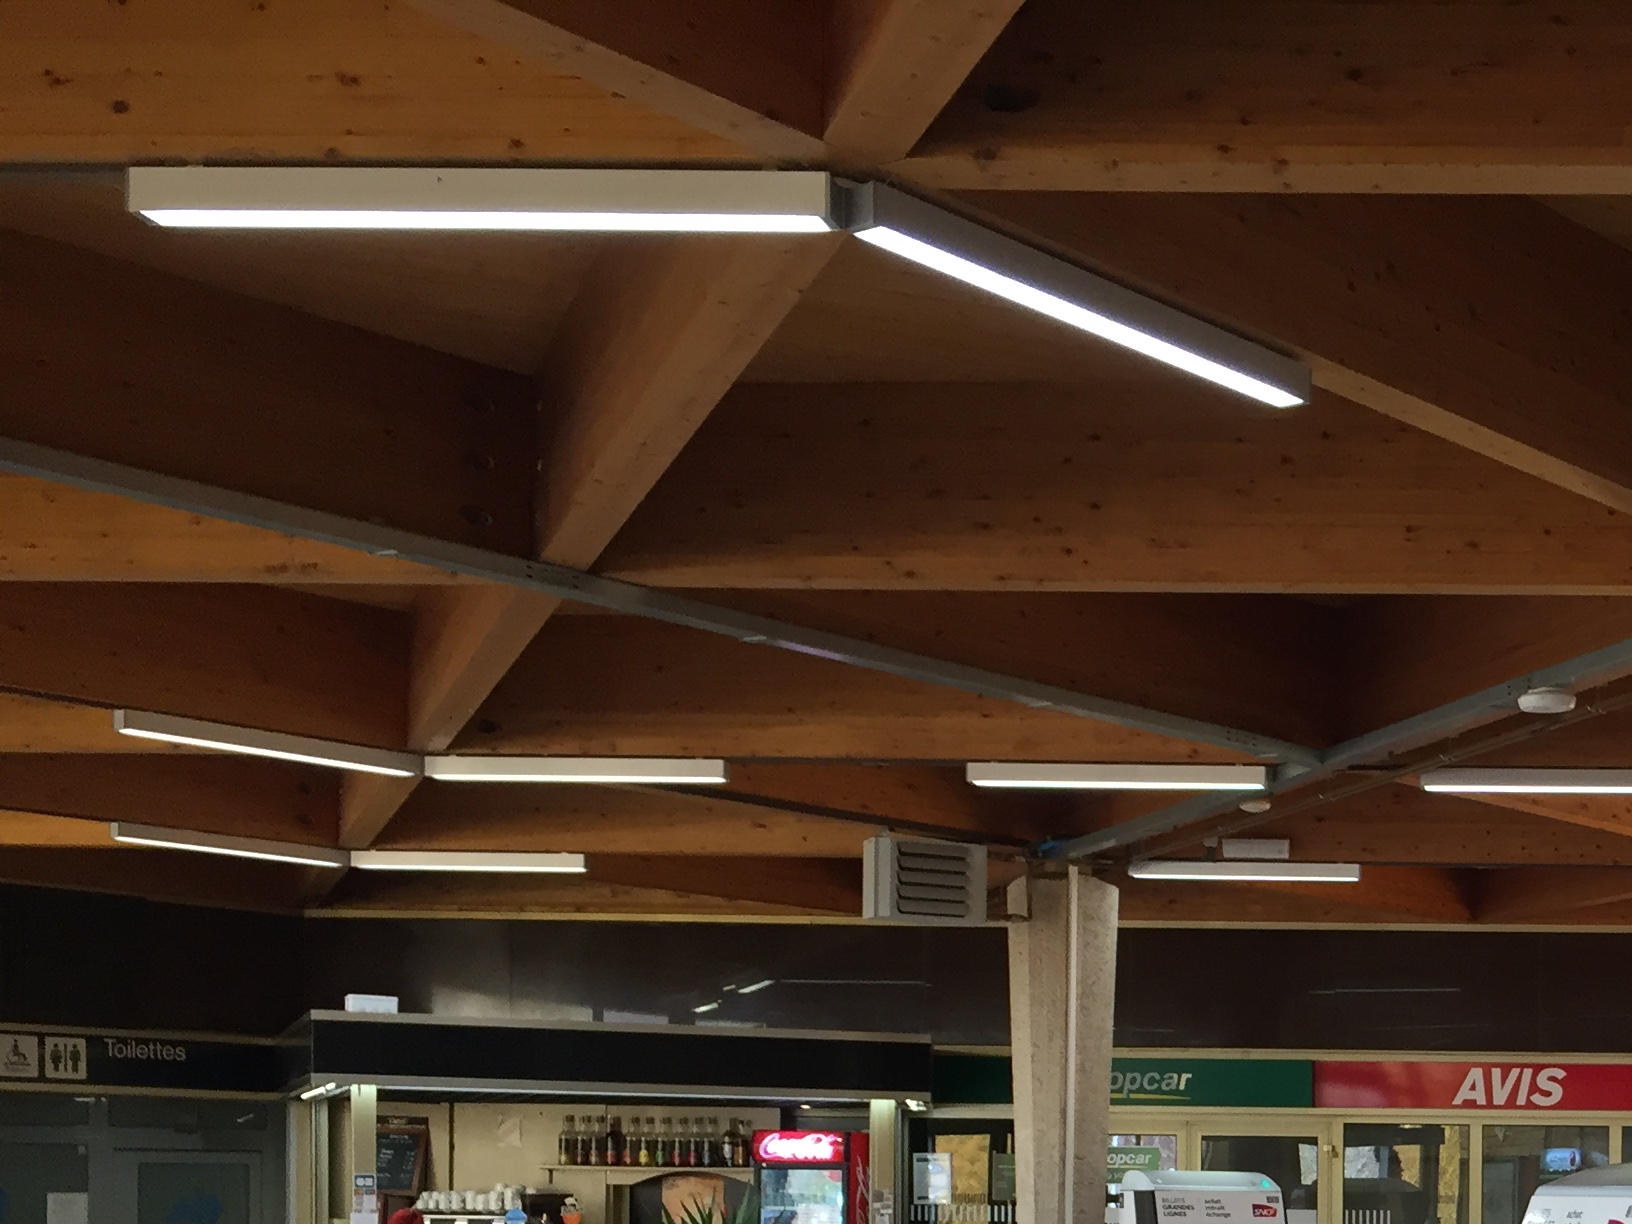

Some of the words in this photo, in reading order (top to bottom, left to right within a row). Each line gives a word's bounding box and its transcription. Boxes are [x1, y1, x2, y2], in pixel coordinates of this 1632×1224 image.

[103, 1038, 187, 1062] Toilettes
[1452, 1067, 1568, 1106] AVIS
[1254, 1208, 1276, 1216] SNCF
